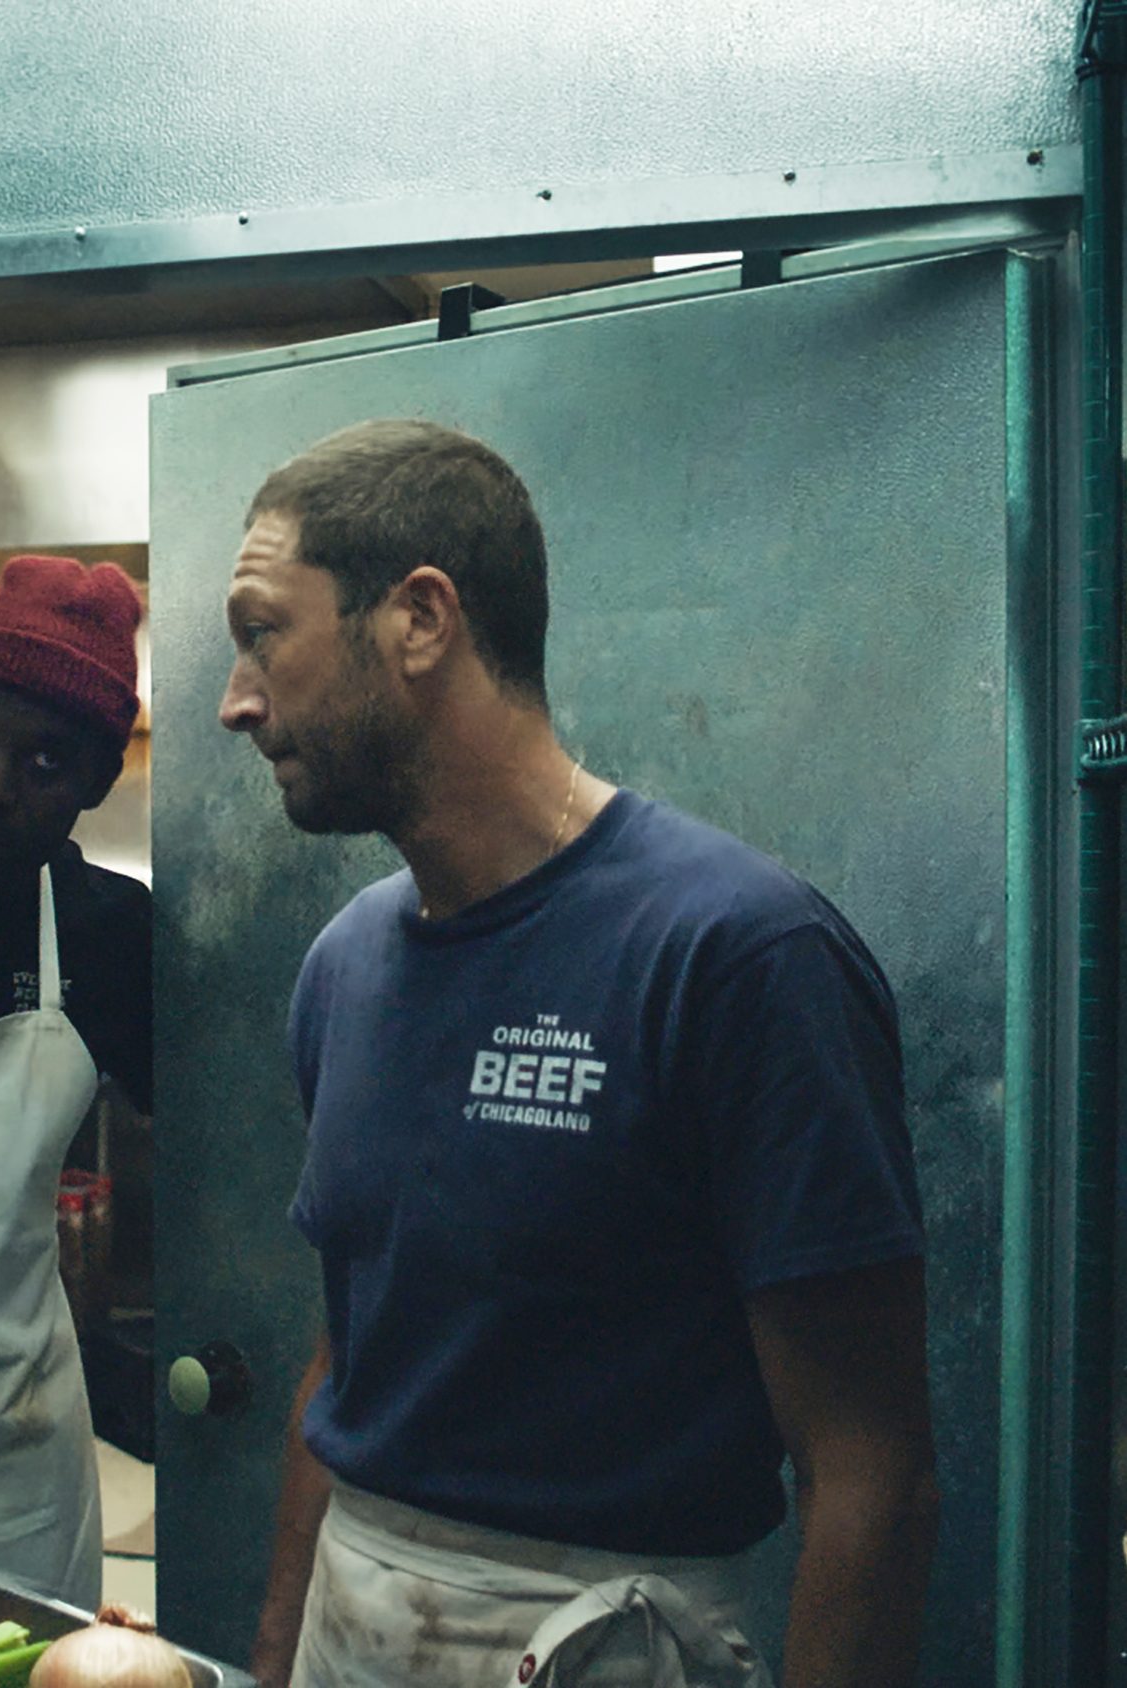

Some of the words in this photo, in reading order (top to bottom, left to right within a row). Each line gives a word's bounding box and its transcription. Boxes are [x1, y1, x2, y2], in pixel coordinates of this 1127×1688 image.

[536, 1013, 560, 1027] THE
[492, 1026, 595, 1051] ORIGINAL
[470, 1050, 607, 1104] BEEF
[463, 1101, 479, 1120] of
[480, 1102, 591, 1132] CHICAGOLAND
